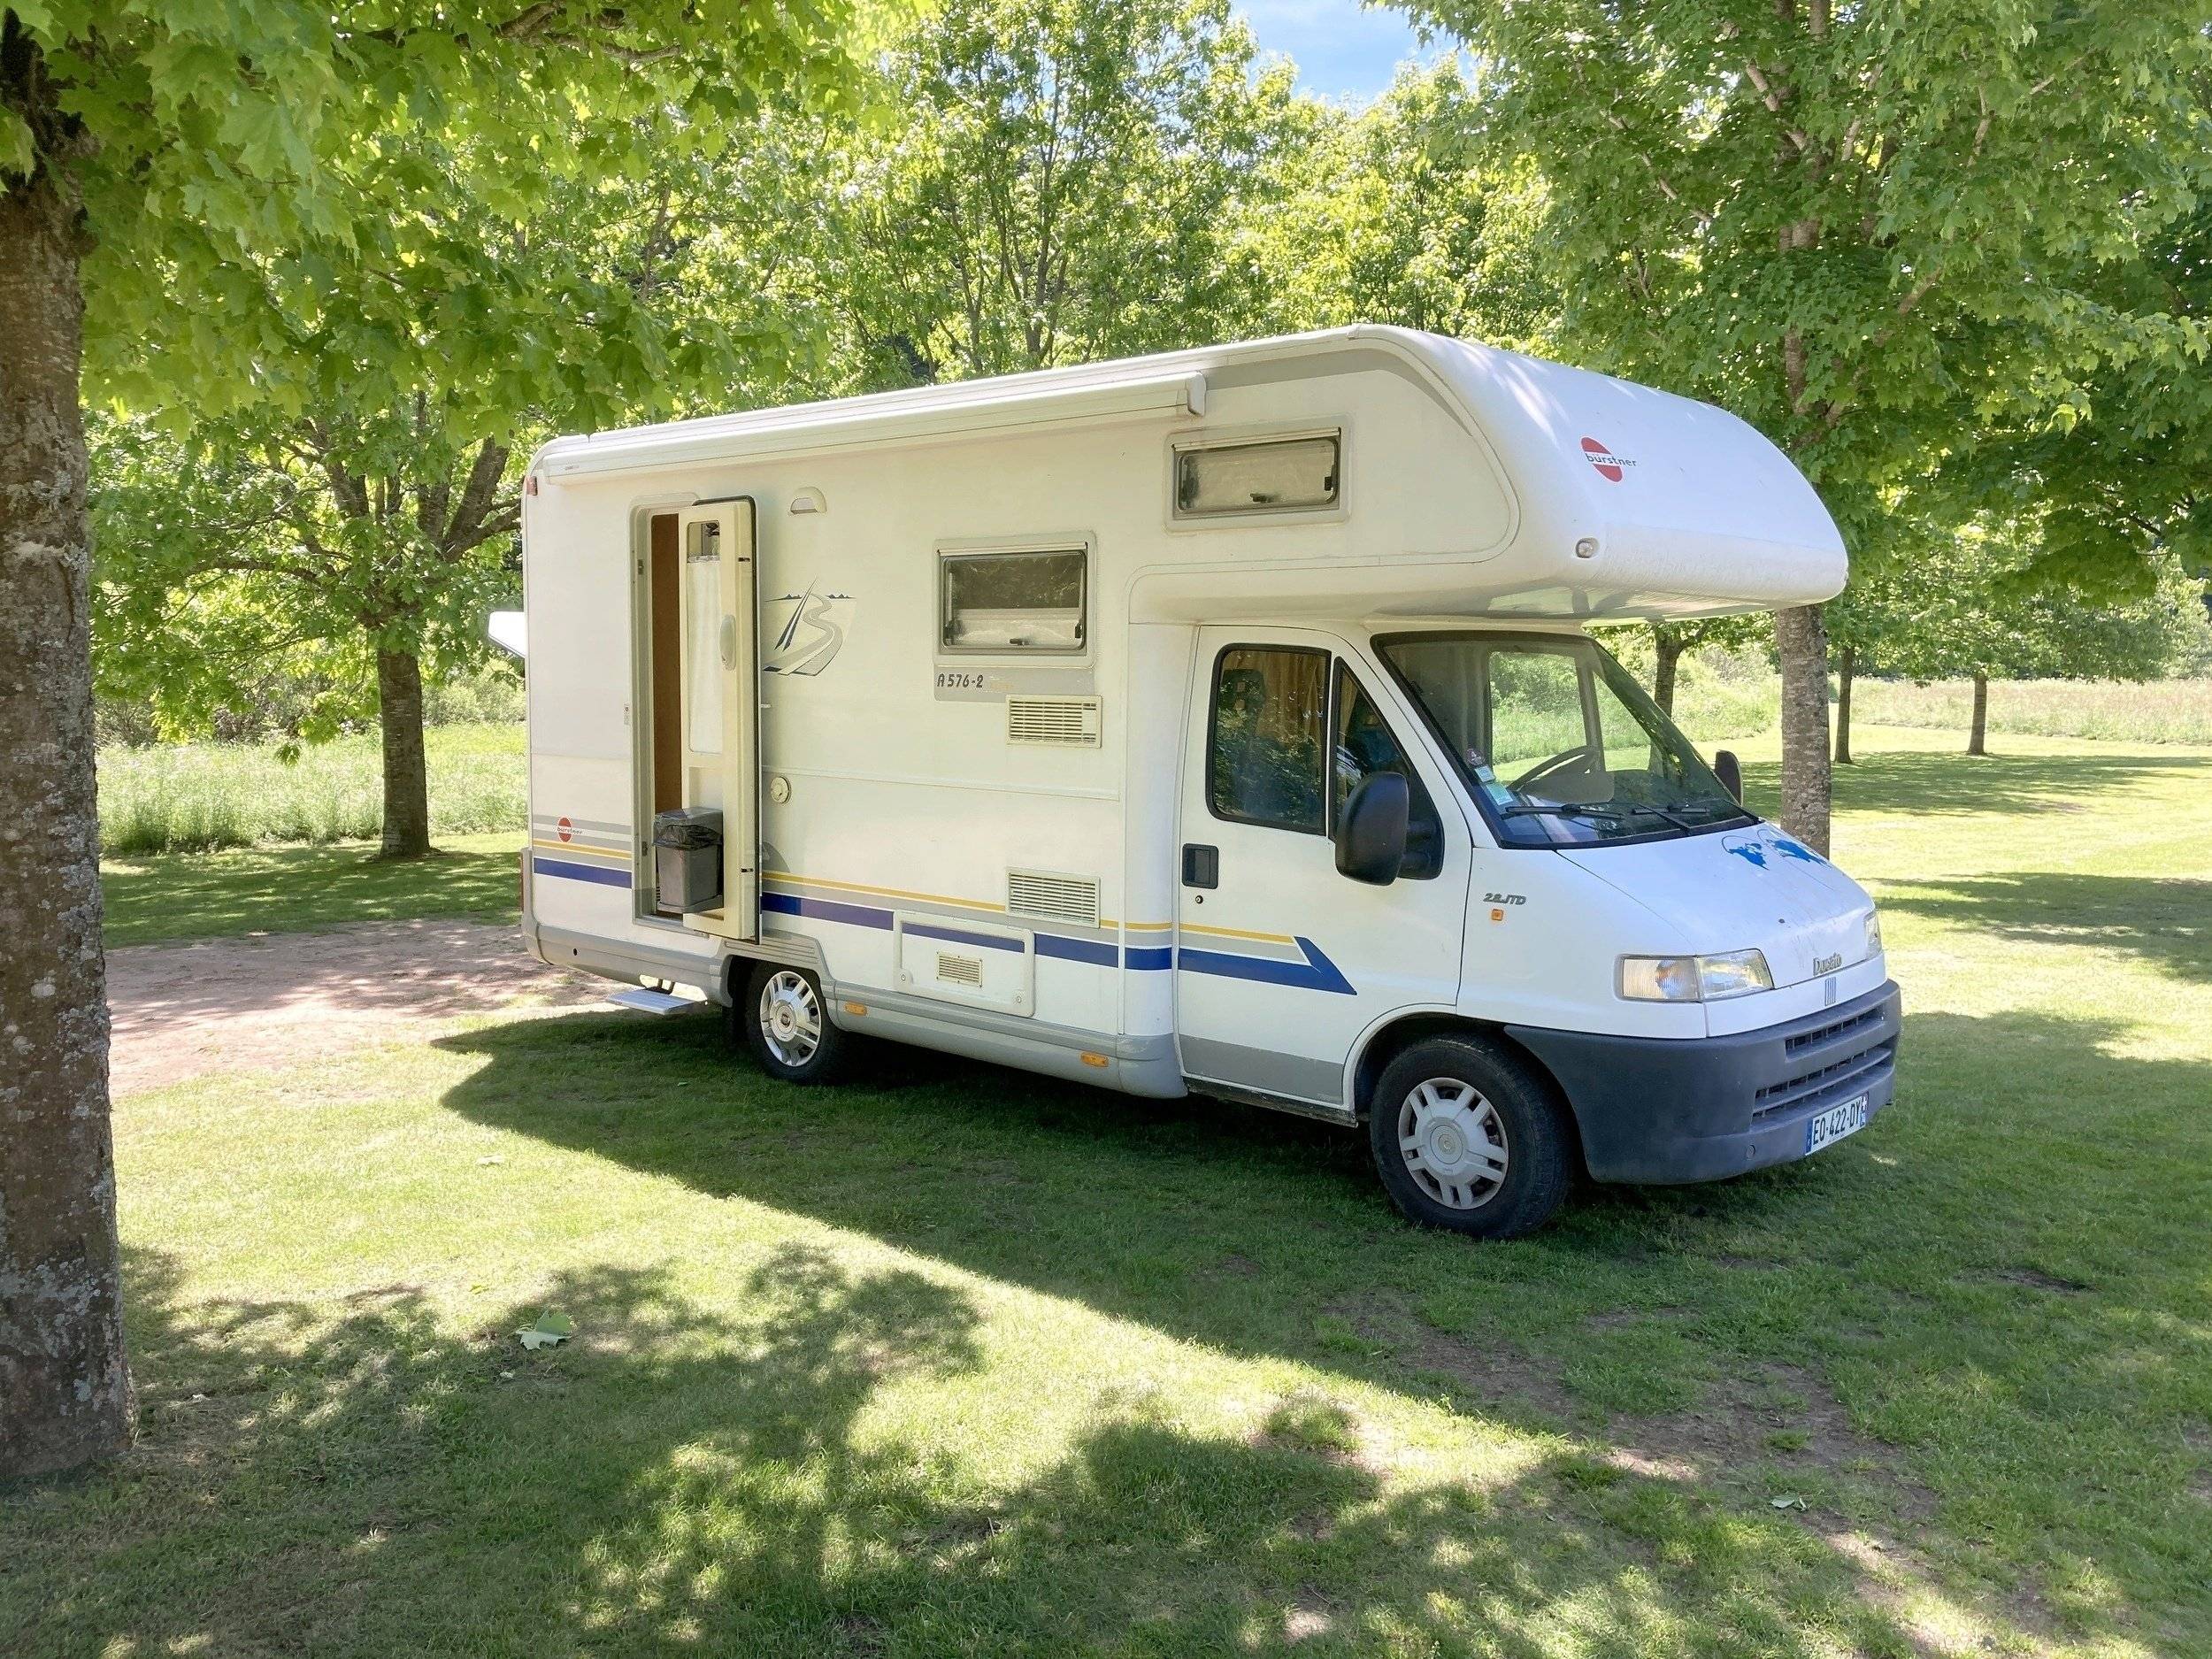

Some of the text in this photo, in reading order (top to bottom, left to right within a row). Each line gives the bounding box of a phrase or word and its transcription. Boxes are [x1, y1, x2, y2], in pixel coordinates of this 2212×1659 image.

[1585, 452, 1637, 467] bürstner
[936, 672, 984, 688] A 576-2
